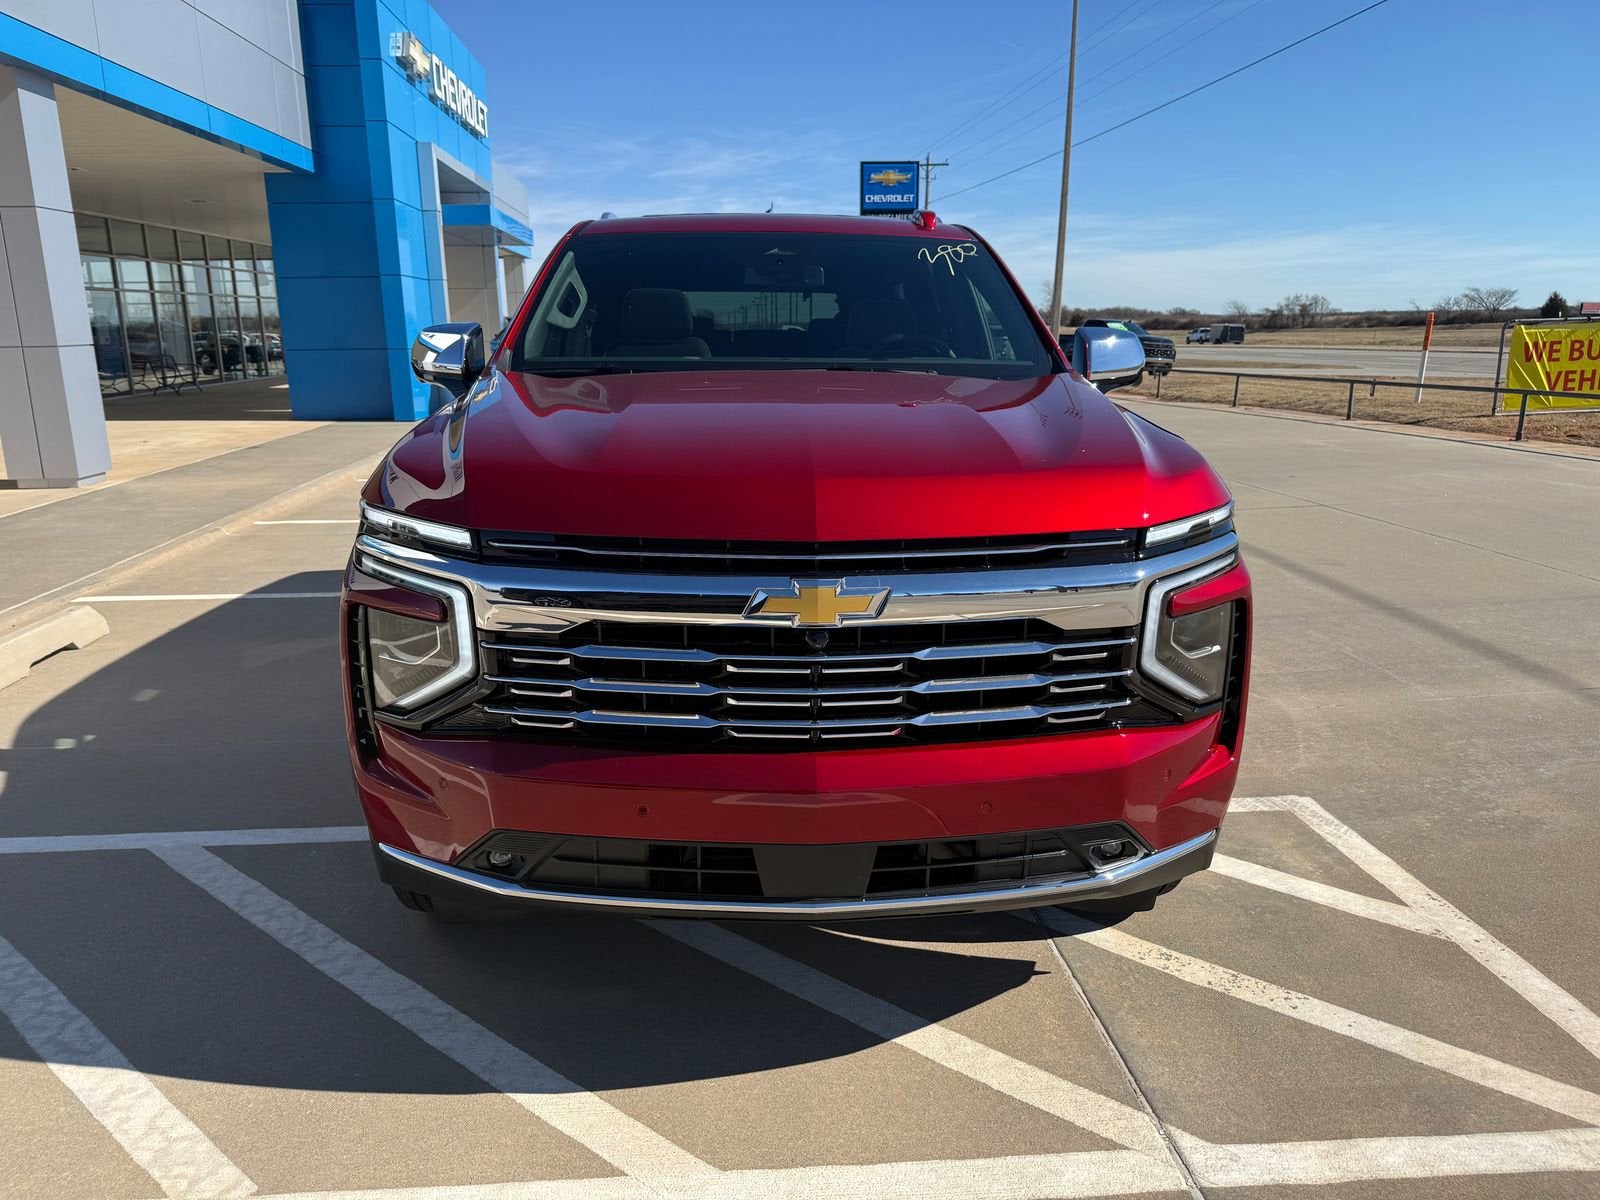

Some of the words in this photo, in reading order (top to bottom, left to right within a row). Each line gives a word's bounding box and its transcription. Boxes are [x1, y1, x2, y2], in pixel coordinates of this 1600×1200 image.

[432, 53, 488, 138] CHEVROLET
[865, 194, 915, 203] CHEVROLET
[1524, 340, 1562, 362] WE
[1568, 338, 1600, 361] BU
[1545, 369, 1600, 391] VEH
